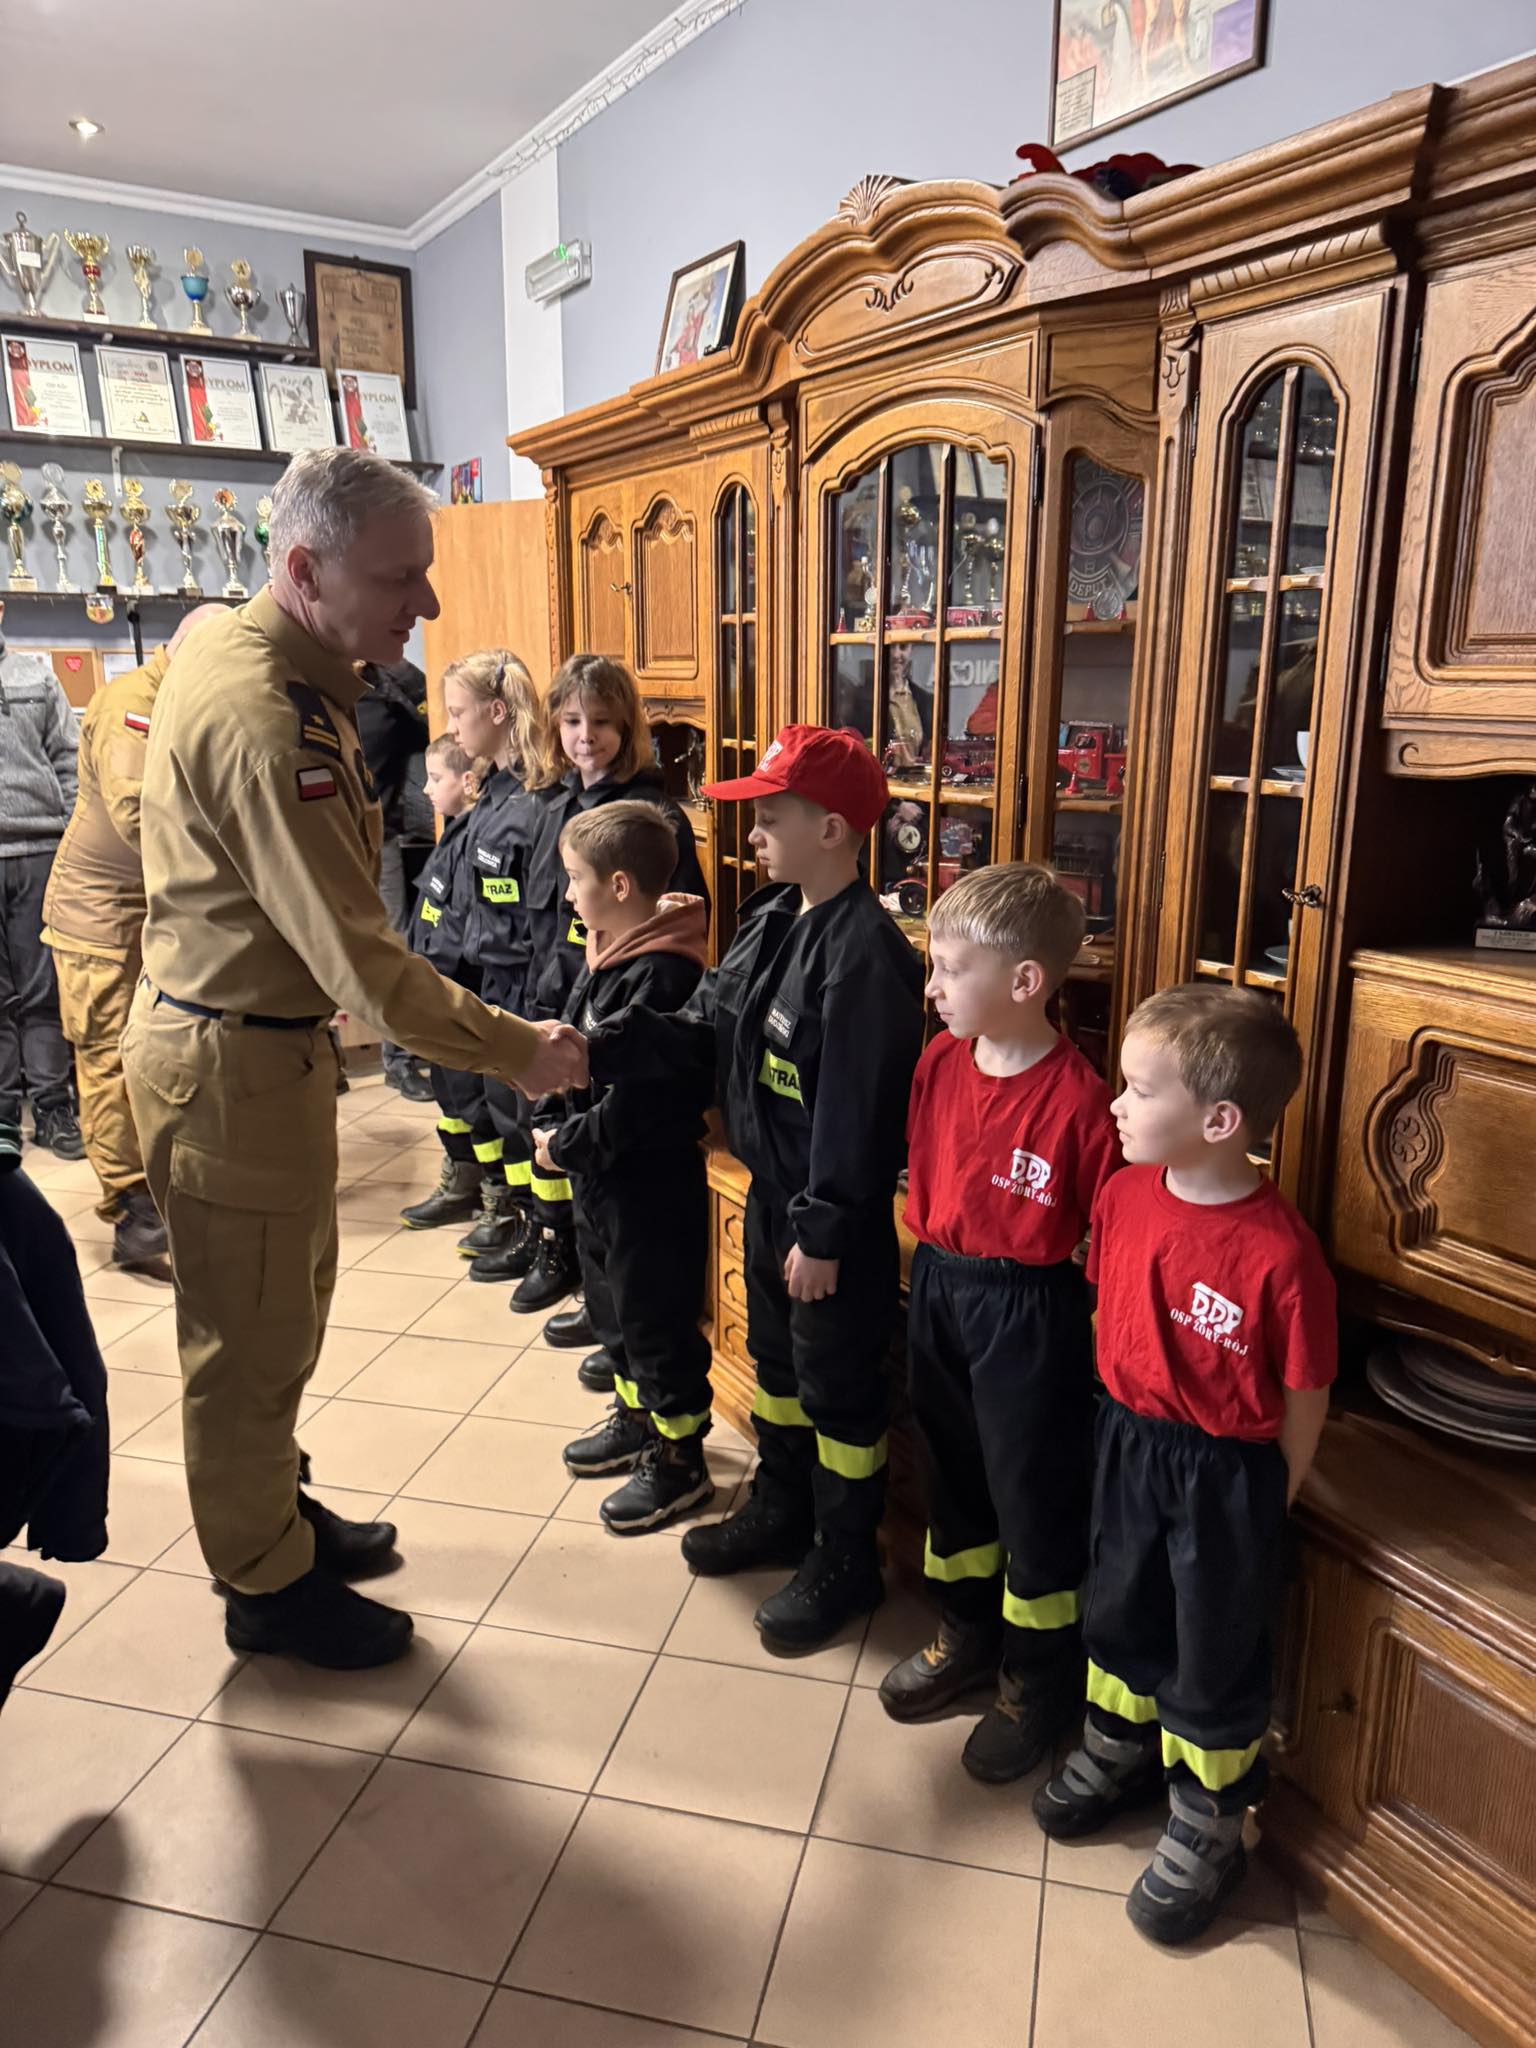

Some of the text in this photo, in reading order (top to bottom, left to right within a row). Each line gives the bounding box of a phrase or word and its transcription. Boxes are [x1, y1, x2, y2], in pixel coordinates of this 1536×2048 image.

[205, 377, 246, 390] YPLOM
[360, 392, 397, 404] YPLOM
[991, 1174, 1011, 1190] OSP
[1170, 1308, 1192, 1326] OSP
